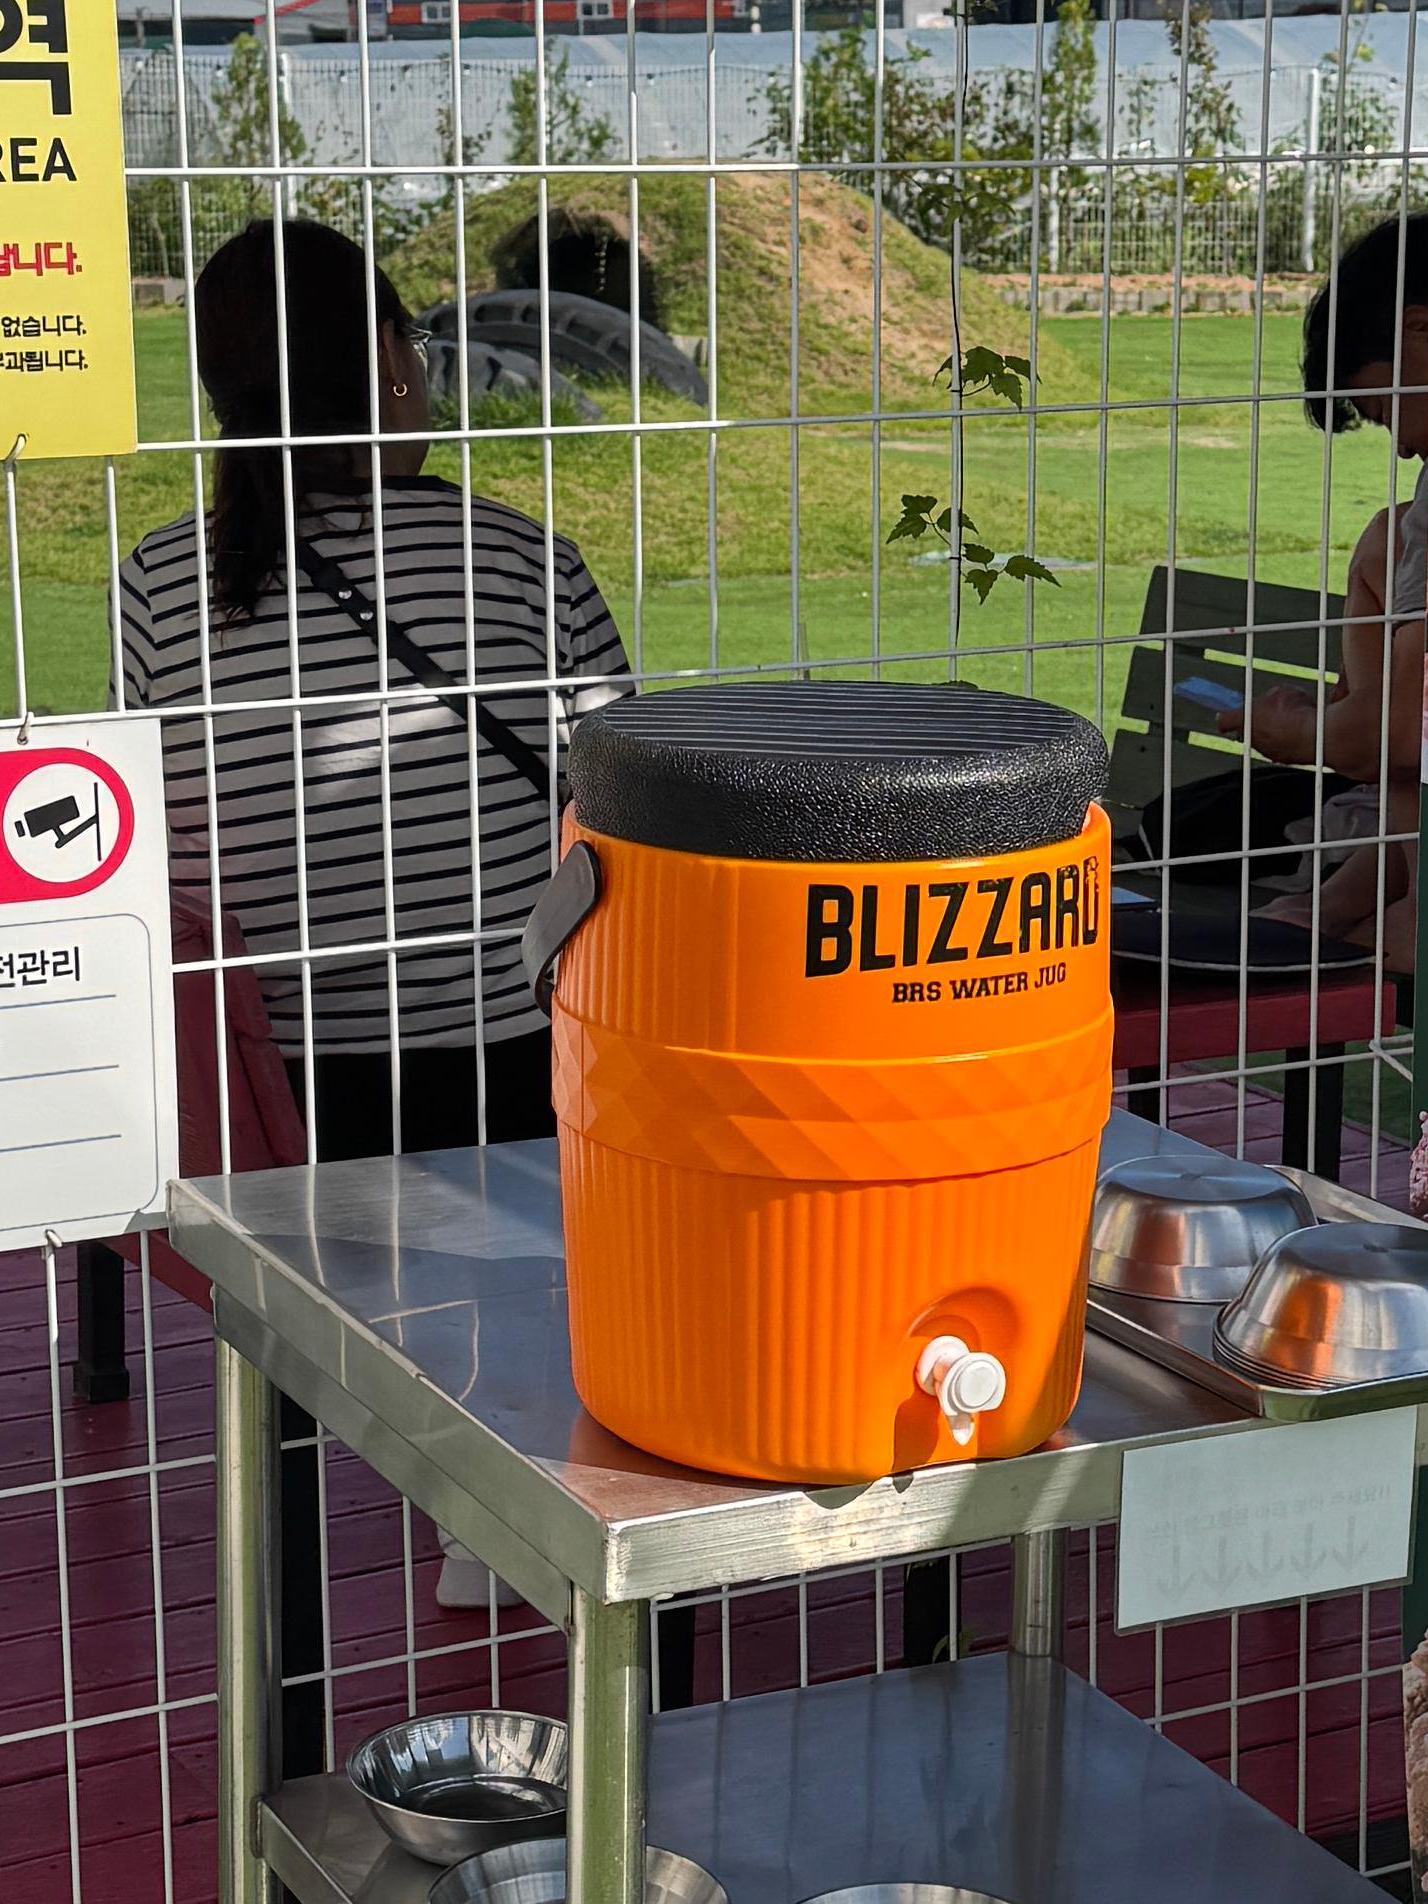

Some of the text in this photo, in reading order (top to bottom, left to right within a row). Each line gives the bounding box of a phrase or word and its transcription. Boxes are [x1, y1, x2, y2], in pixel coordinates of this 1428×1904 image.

[1, 314, 87, 337] 없습니다.
[804, 855, 1099, 979] BLIZZARD
[891, 962, 1067, 1004] BRS WATER JUG
